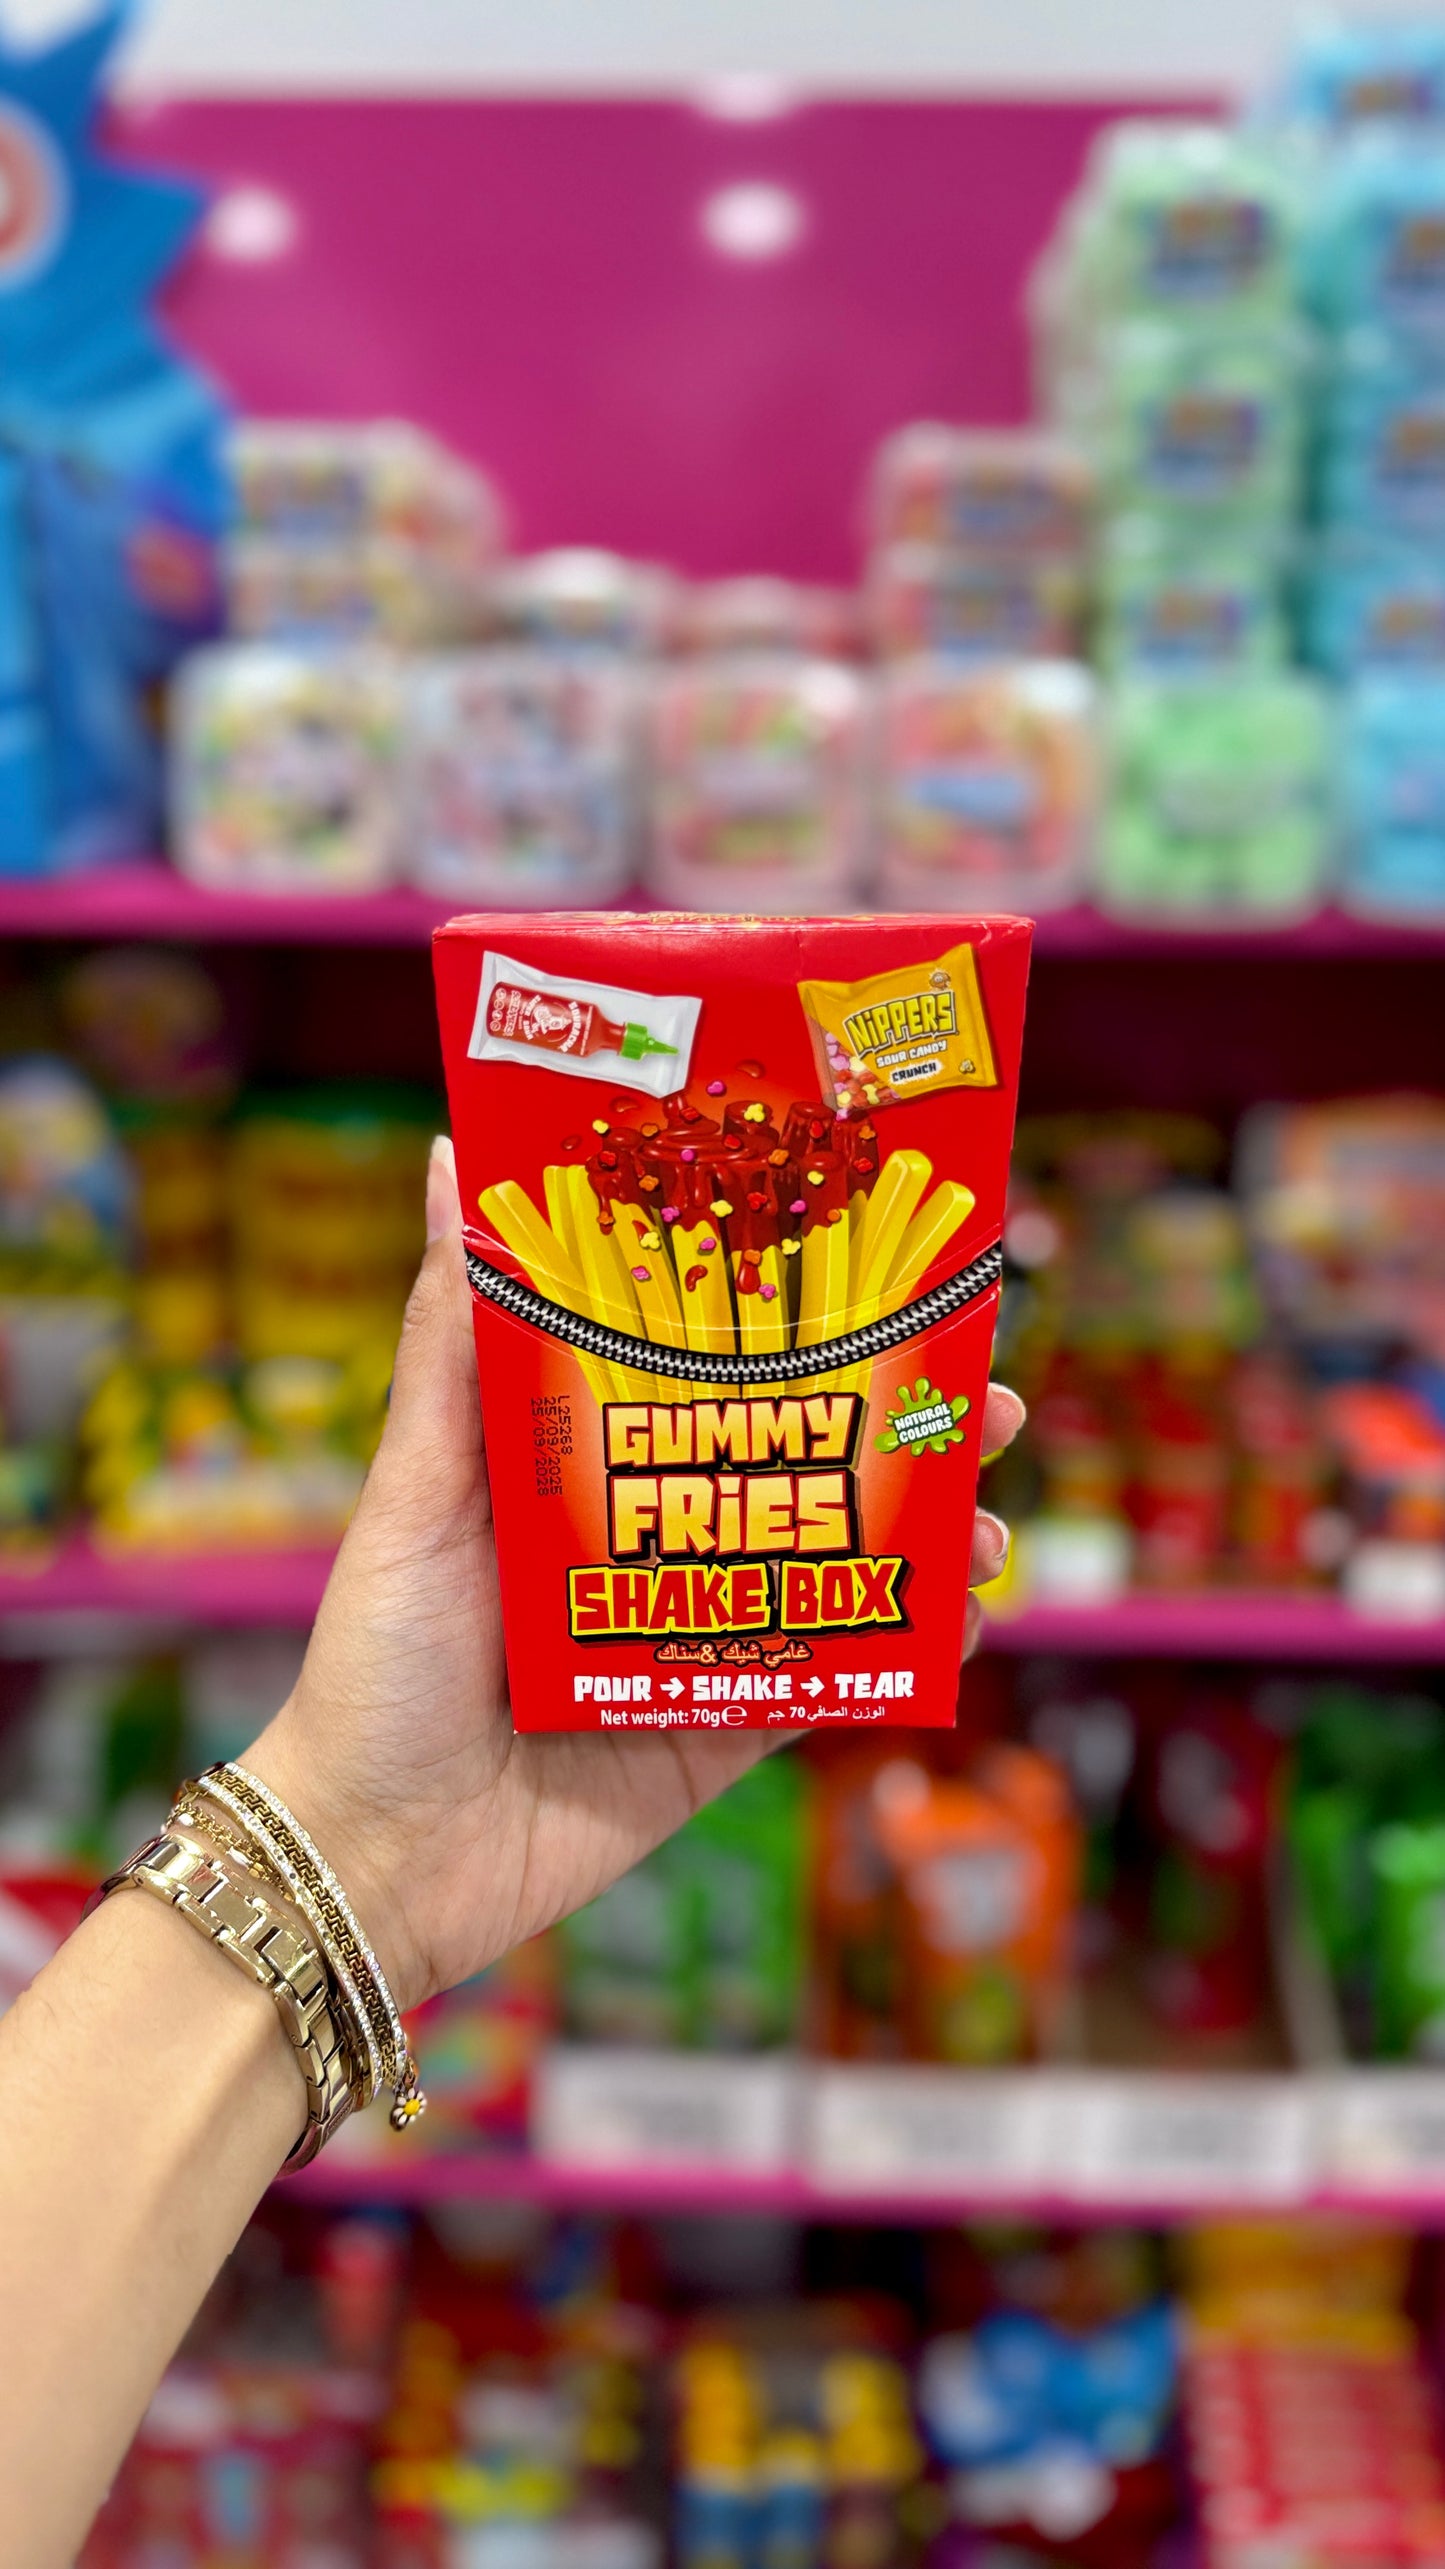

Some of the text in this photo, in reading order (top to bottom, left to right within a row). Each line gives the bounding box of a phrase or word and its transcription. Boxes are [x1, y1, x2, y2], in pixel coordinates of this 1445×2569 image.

[876, 1040, 948, 1068] SOUR CANDY
[891, 1062, 938, 1082] CRUNCH
[604, 1393, 862, 1469] GUMMY
[894, 1403, 951, 1431] NATURAL
[899, 1416, 953, 1443] COLOURS
[530, 1397, 549, 1496] 25/09/2028
[544, 1396, 563, 1495] 25/09/2025
[569, 1556, 904, 1635] SHAKE BOX
[574, 1670, 915, 1702] POUR SHAKE TEAR
[600, 1709, 629, 1725] Net
[631, 1708, 690, 1729] weight:
[766, 1704, 885, 1724] الوزن الصافي 70 جم
